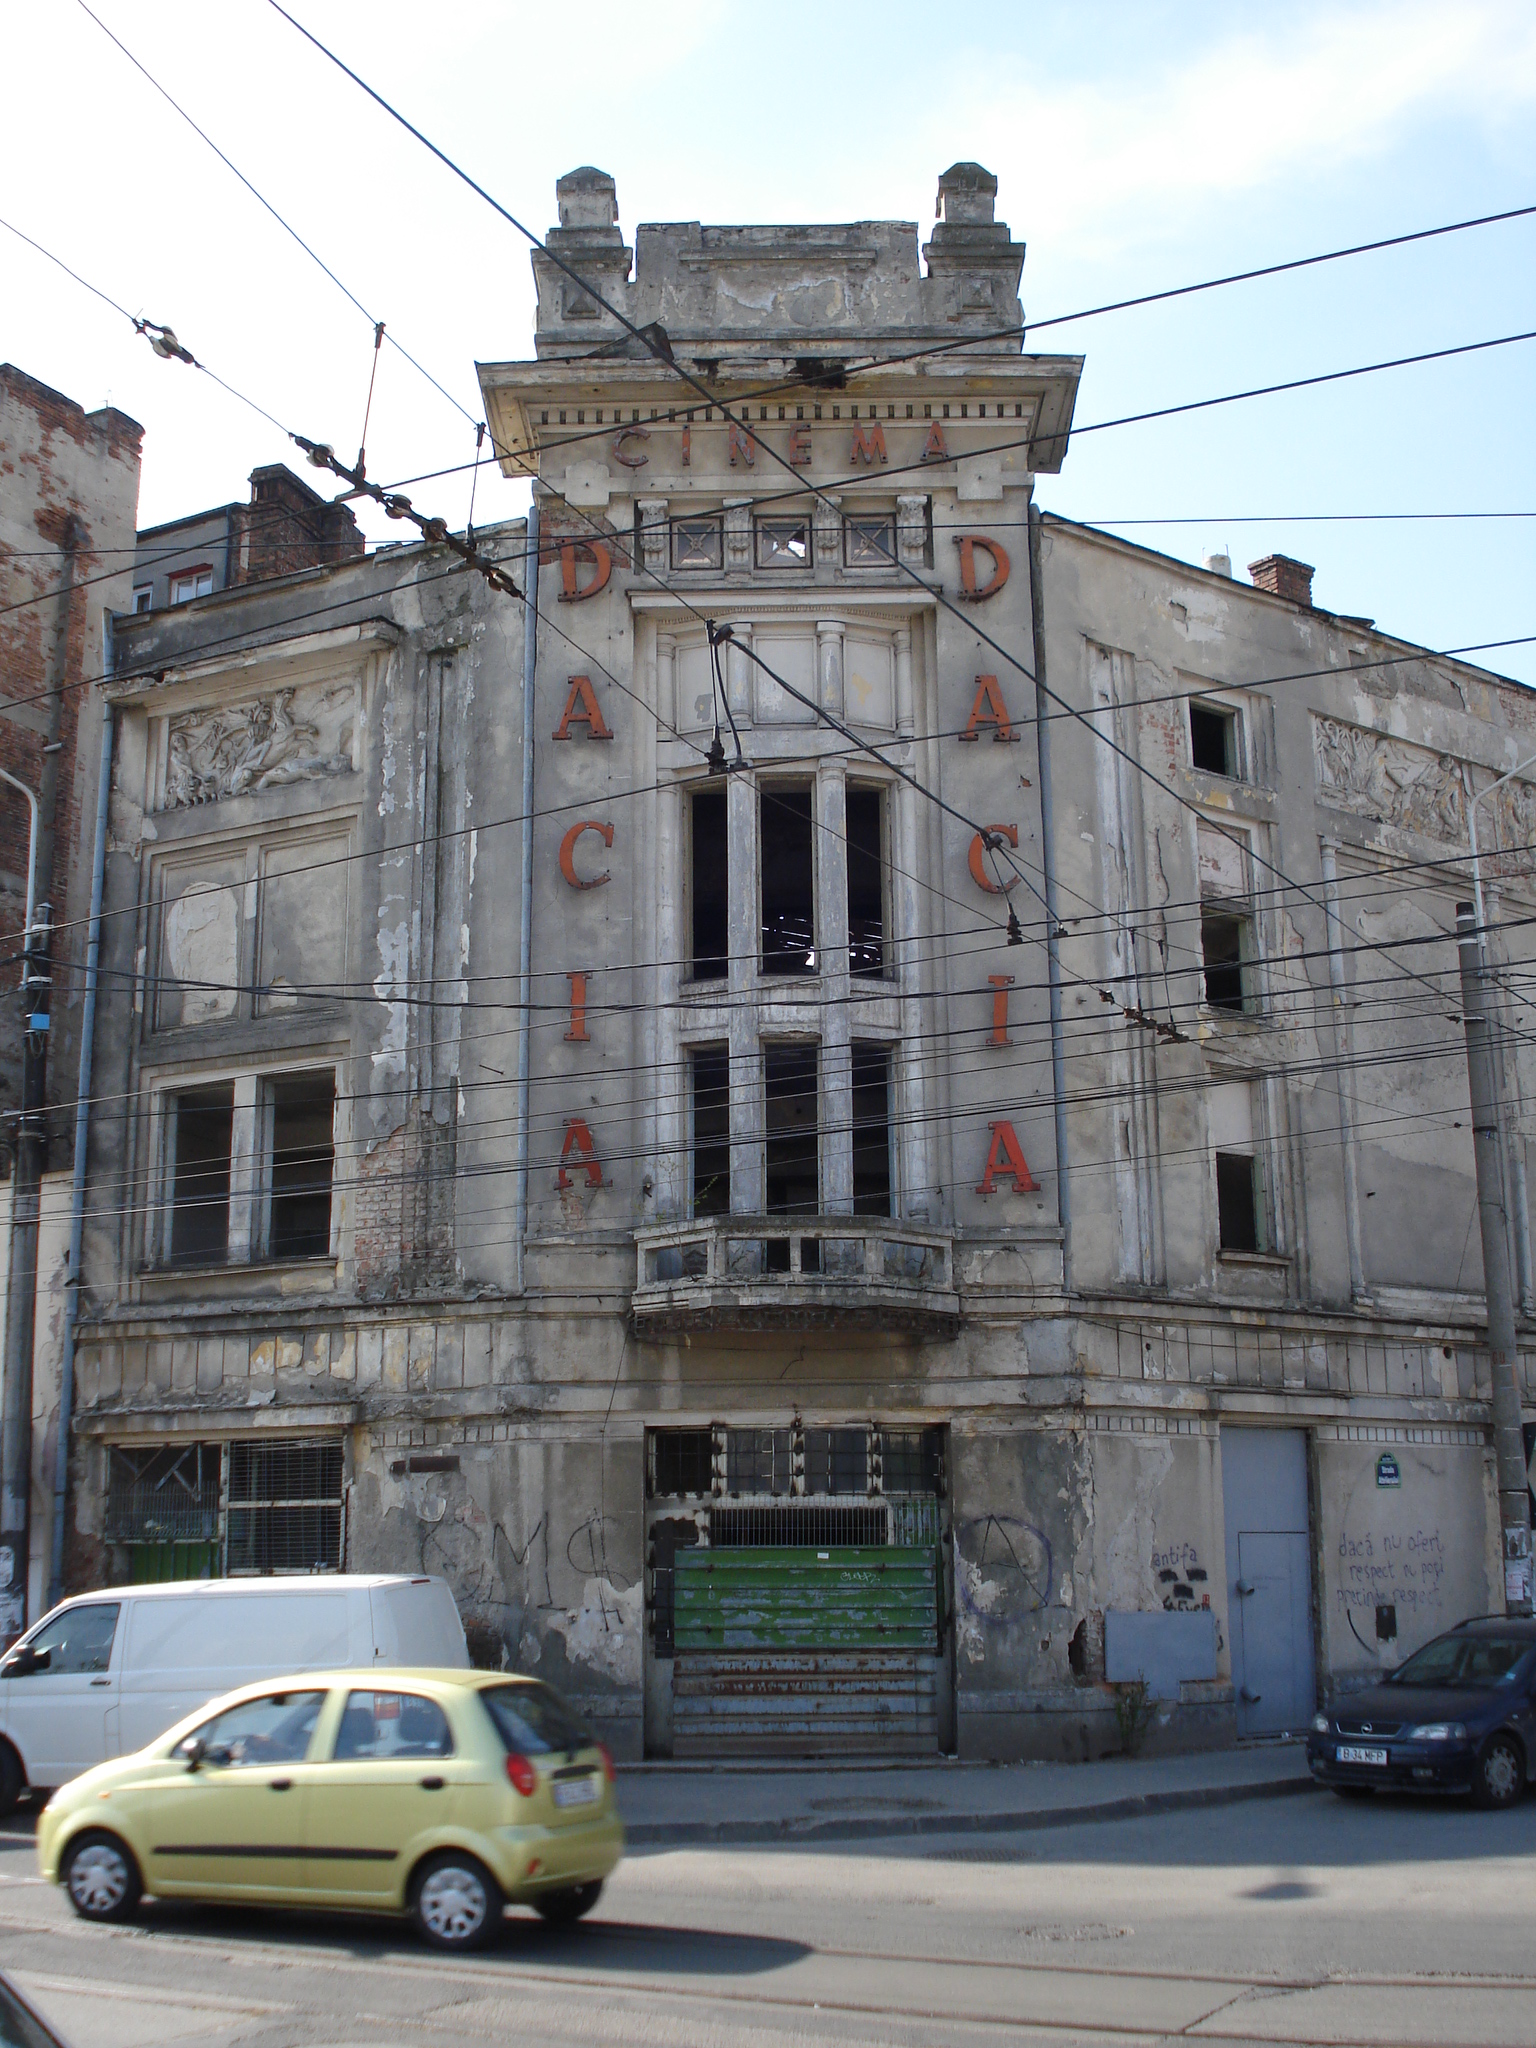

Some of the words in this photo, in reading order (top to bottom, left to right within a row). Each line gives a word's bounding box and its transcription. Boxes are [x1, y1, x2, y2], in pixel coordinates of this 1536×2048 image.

[611, 421, 951, 468] CINEMA
[552, 536, 614, 1190] DACIA
[951, 535, 1042, 1194] DACIA
[1152, 1542, 1197, 1569] antifa
[1350, 1561, 1395, 1586] respect
